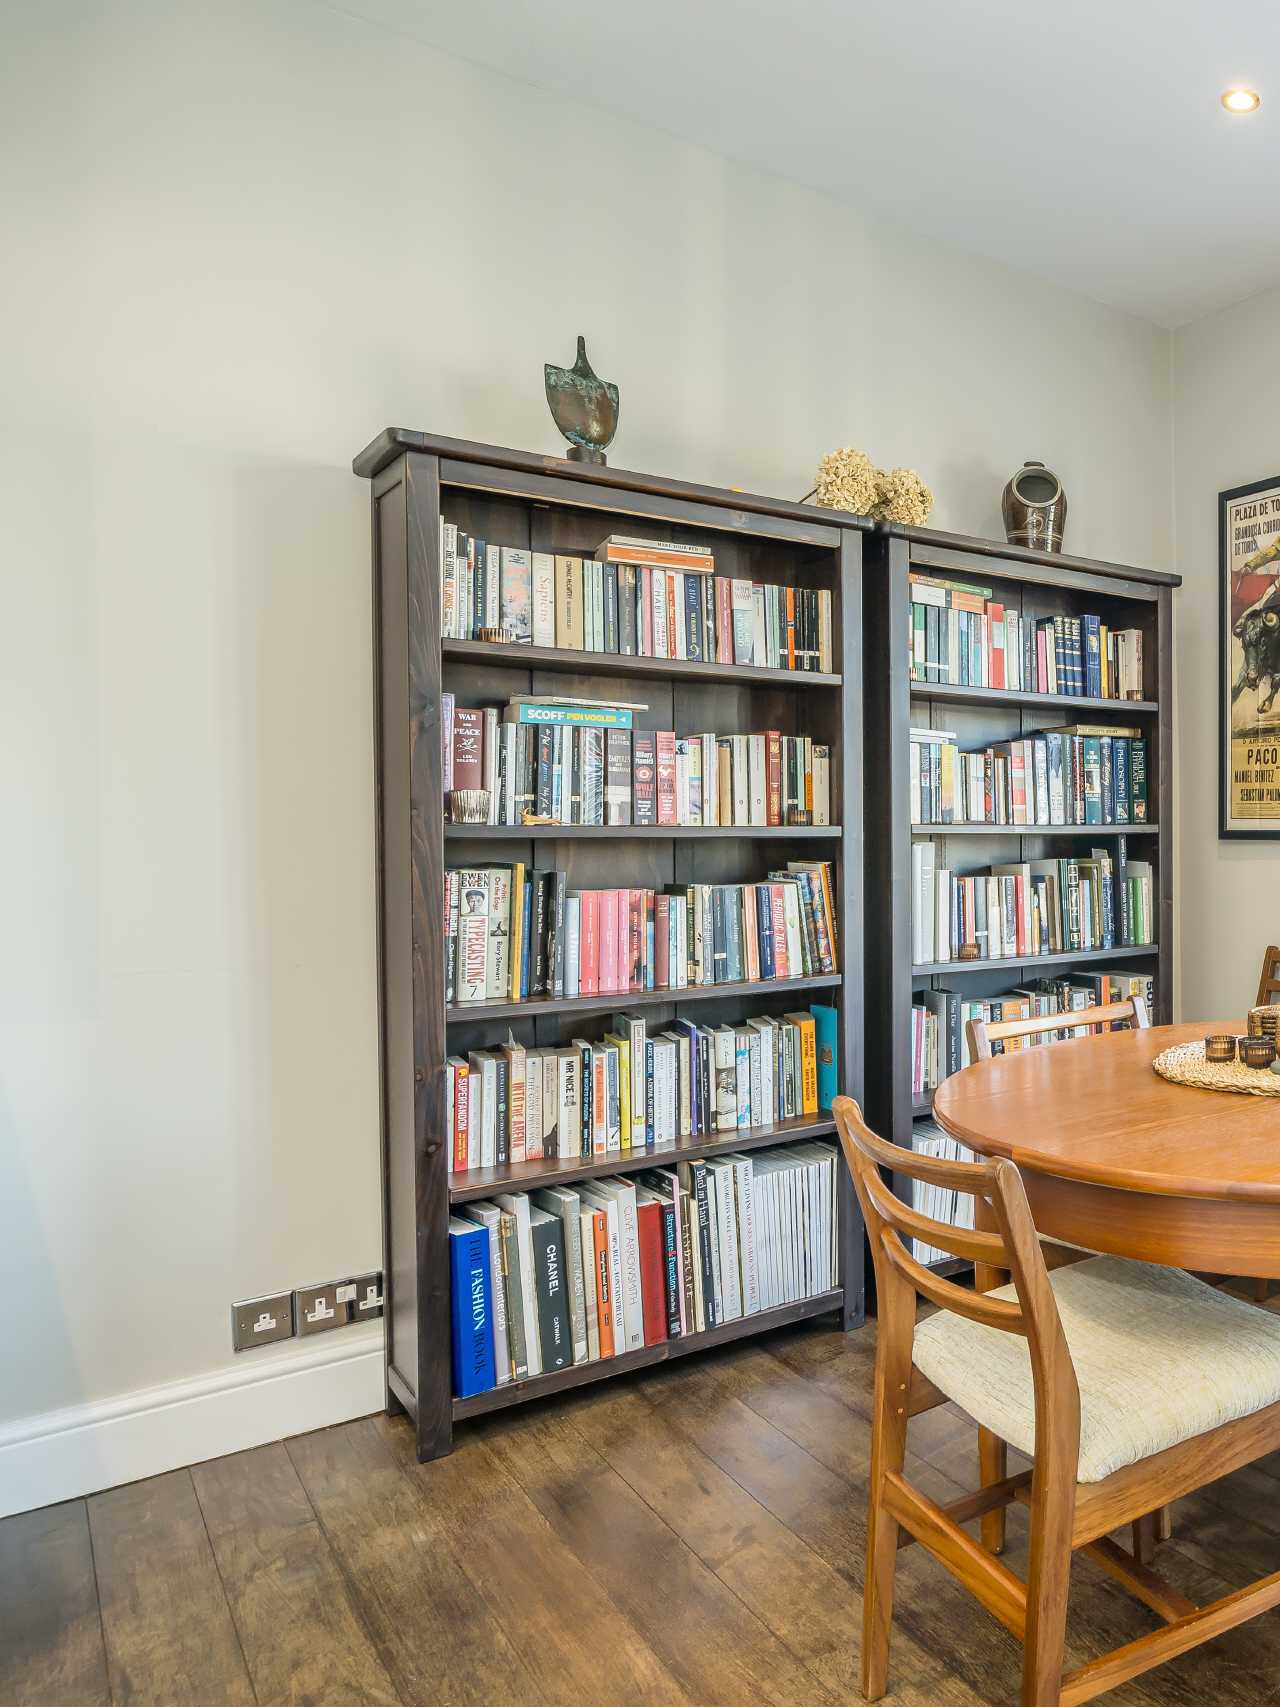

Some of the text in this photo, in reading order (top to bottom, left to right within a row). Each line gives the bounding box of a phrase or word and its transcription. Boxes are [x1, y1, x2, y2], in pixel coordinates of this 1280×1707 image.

[1234, 507, 1257, 522] PLAZA
[1260, 503, 1271, 515] DE
[537, 576, 552, 623] Sapiens
[454, 728, 481, 736] PEACE
[458, 713, 476, 721] WAR
[527, 709, 565, 721] SCOFF
[1117, 749, 1125, 799] PHILOSOPHY
[1137, 751, 1145, 782] ENGLISH
[1247, 748, 1277, 765] PACO
[461, 880, 489, 888] EWEN
[495, 876, 501, 886] On
[492, 897, 500, 911] Edge
[774, 898, 785, 952] PERIODIC TALES
[466, 918, 485, 984] TYPECASTING
[565, 1060, 575, 1094] MR NICE
[458, 1078, 467, 1131] SUPERFANDOM
[512, 1082, 525, 1149] INTO THE ARENA
[696, 1169, 709, 1226] Bird in Hand
[666, 1214, 675, 1250] Structure
[493, 1252, 504, 1290] London
[546, 1244, 559, 1297] CHANEL
[624, 1206, 637, 1306] CLIVE ARROWSMITH
[668, 1257, 677, 1290] Function
[682, 1224, 693, 1298] LANDSCAPE
[470, 1239, 485, 1376] THE FASHION BOOK
